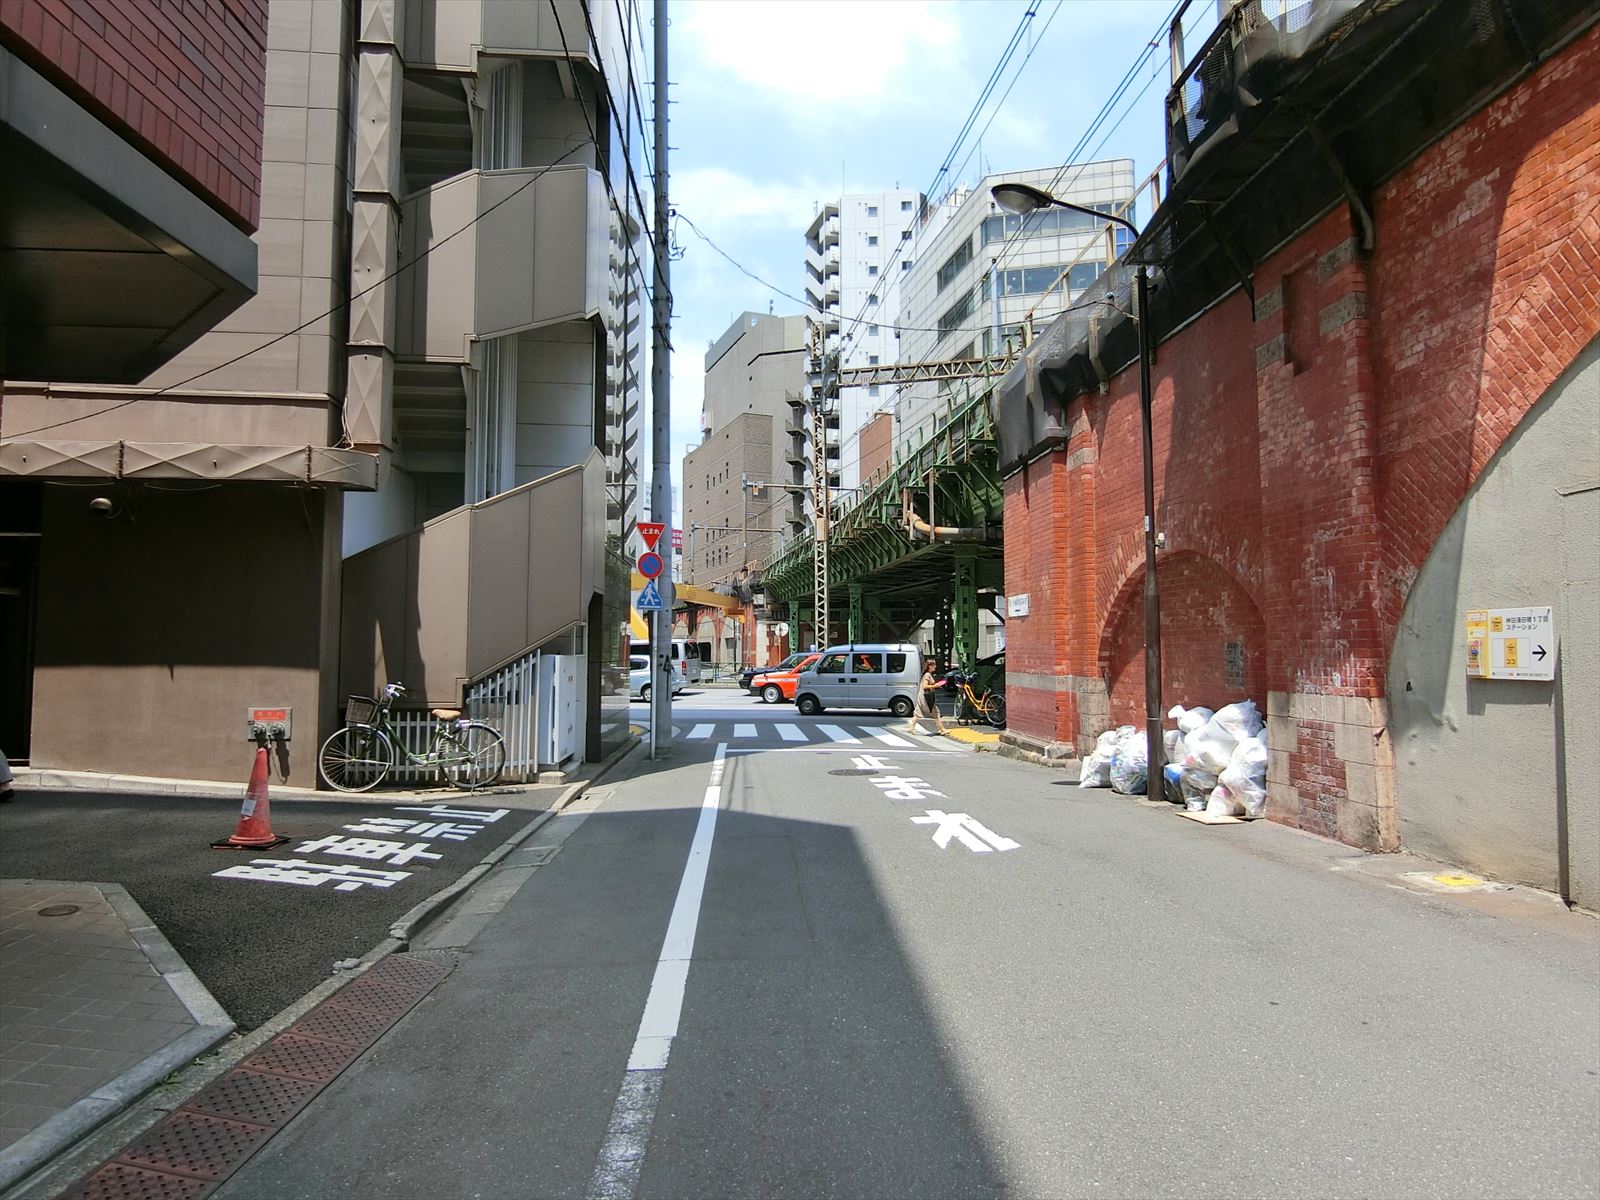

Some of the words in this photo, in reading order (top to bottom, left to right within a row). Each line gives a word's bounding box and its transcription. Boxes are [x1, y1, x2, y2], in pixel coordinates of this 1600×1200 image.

[642, 527, 660, 535] 止まれ
[850, 754, 1022, 852] 止まれ
[211, 805, 511, 891] 駐車禁止
